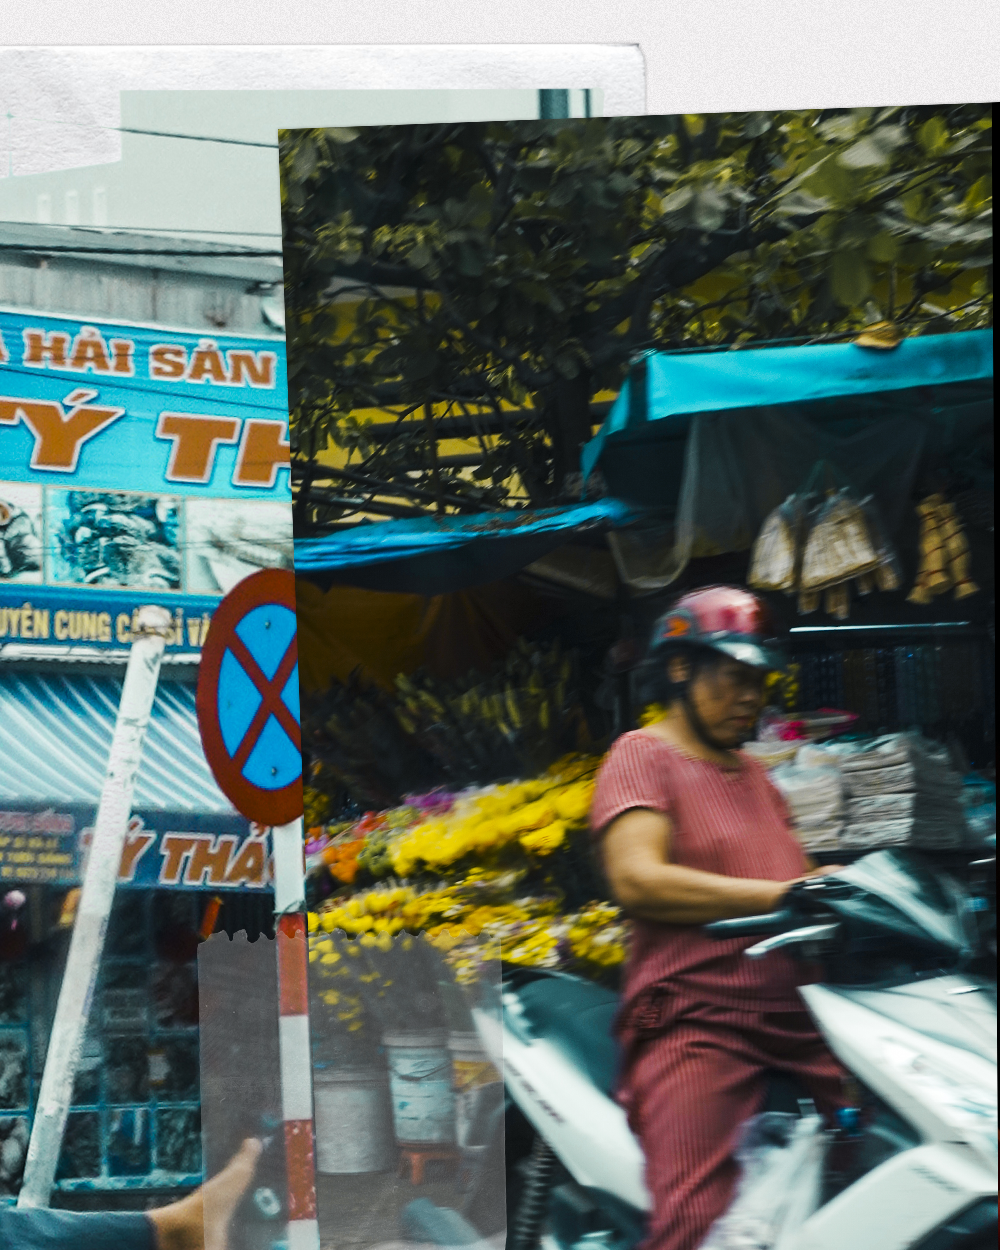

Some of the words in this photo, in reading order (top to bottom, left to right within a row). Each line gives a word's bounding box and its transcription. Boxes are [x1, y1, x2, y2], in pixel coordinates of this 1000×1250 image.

[23, 326, 134, 378] HẢI
[150, 339, 277, 390] SẢN
[54, 610, 111, 643] CUNG
